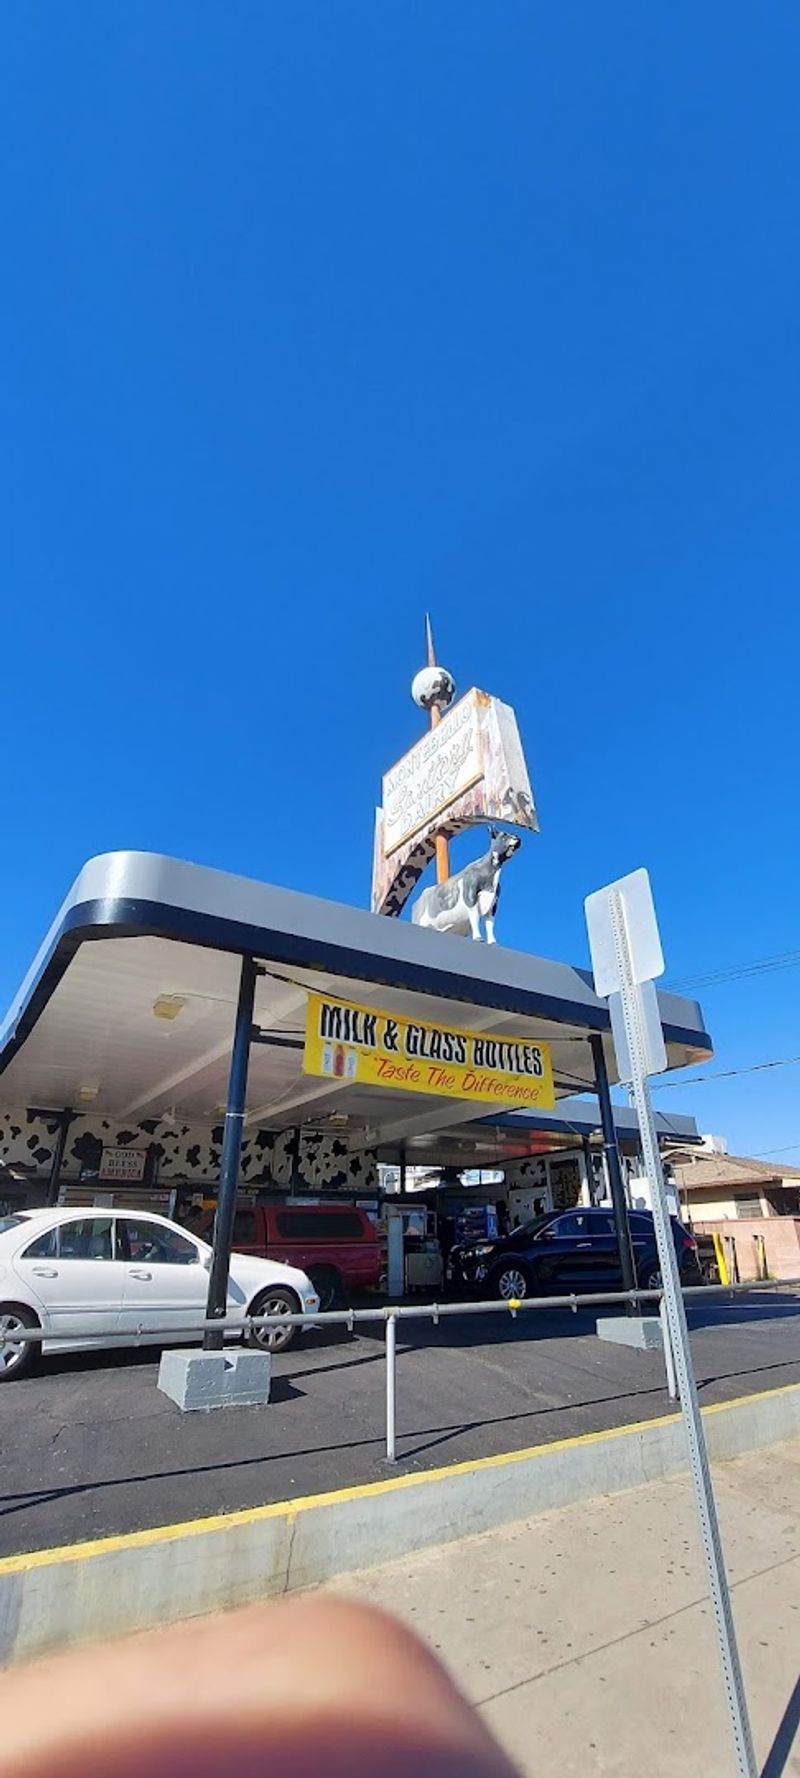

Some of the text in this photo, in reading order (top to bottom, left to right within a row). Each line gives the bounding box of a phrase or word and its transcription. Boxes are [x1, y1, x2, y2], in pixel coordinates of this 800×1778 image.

[386, 702, 473, 798] MONTEBELLO
[401, 767, 461, 837] DAIRY
[320, 1003, 544, 1076] MILK & GLASS BOTTLES
[427, 1066, 455, 1089] The
[108, 1159, 138, 1168] BLESS
[115, 1151, 135, 1159] GOD
[102, 1168, 142, 1178] AMERICA
